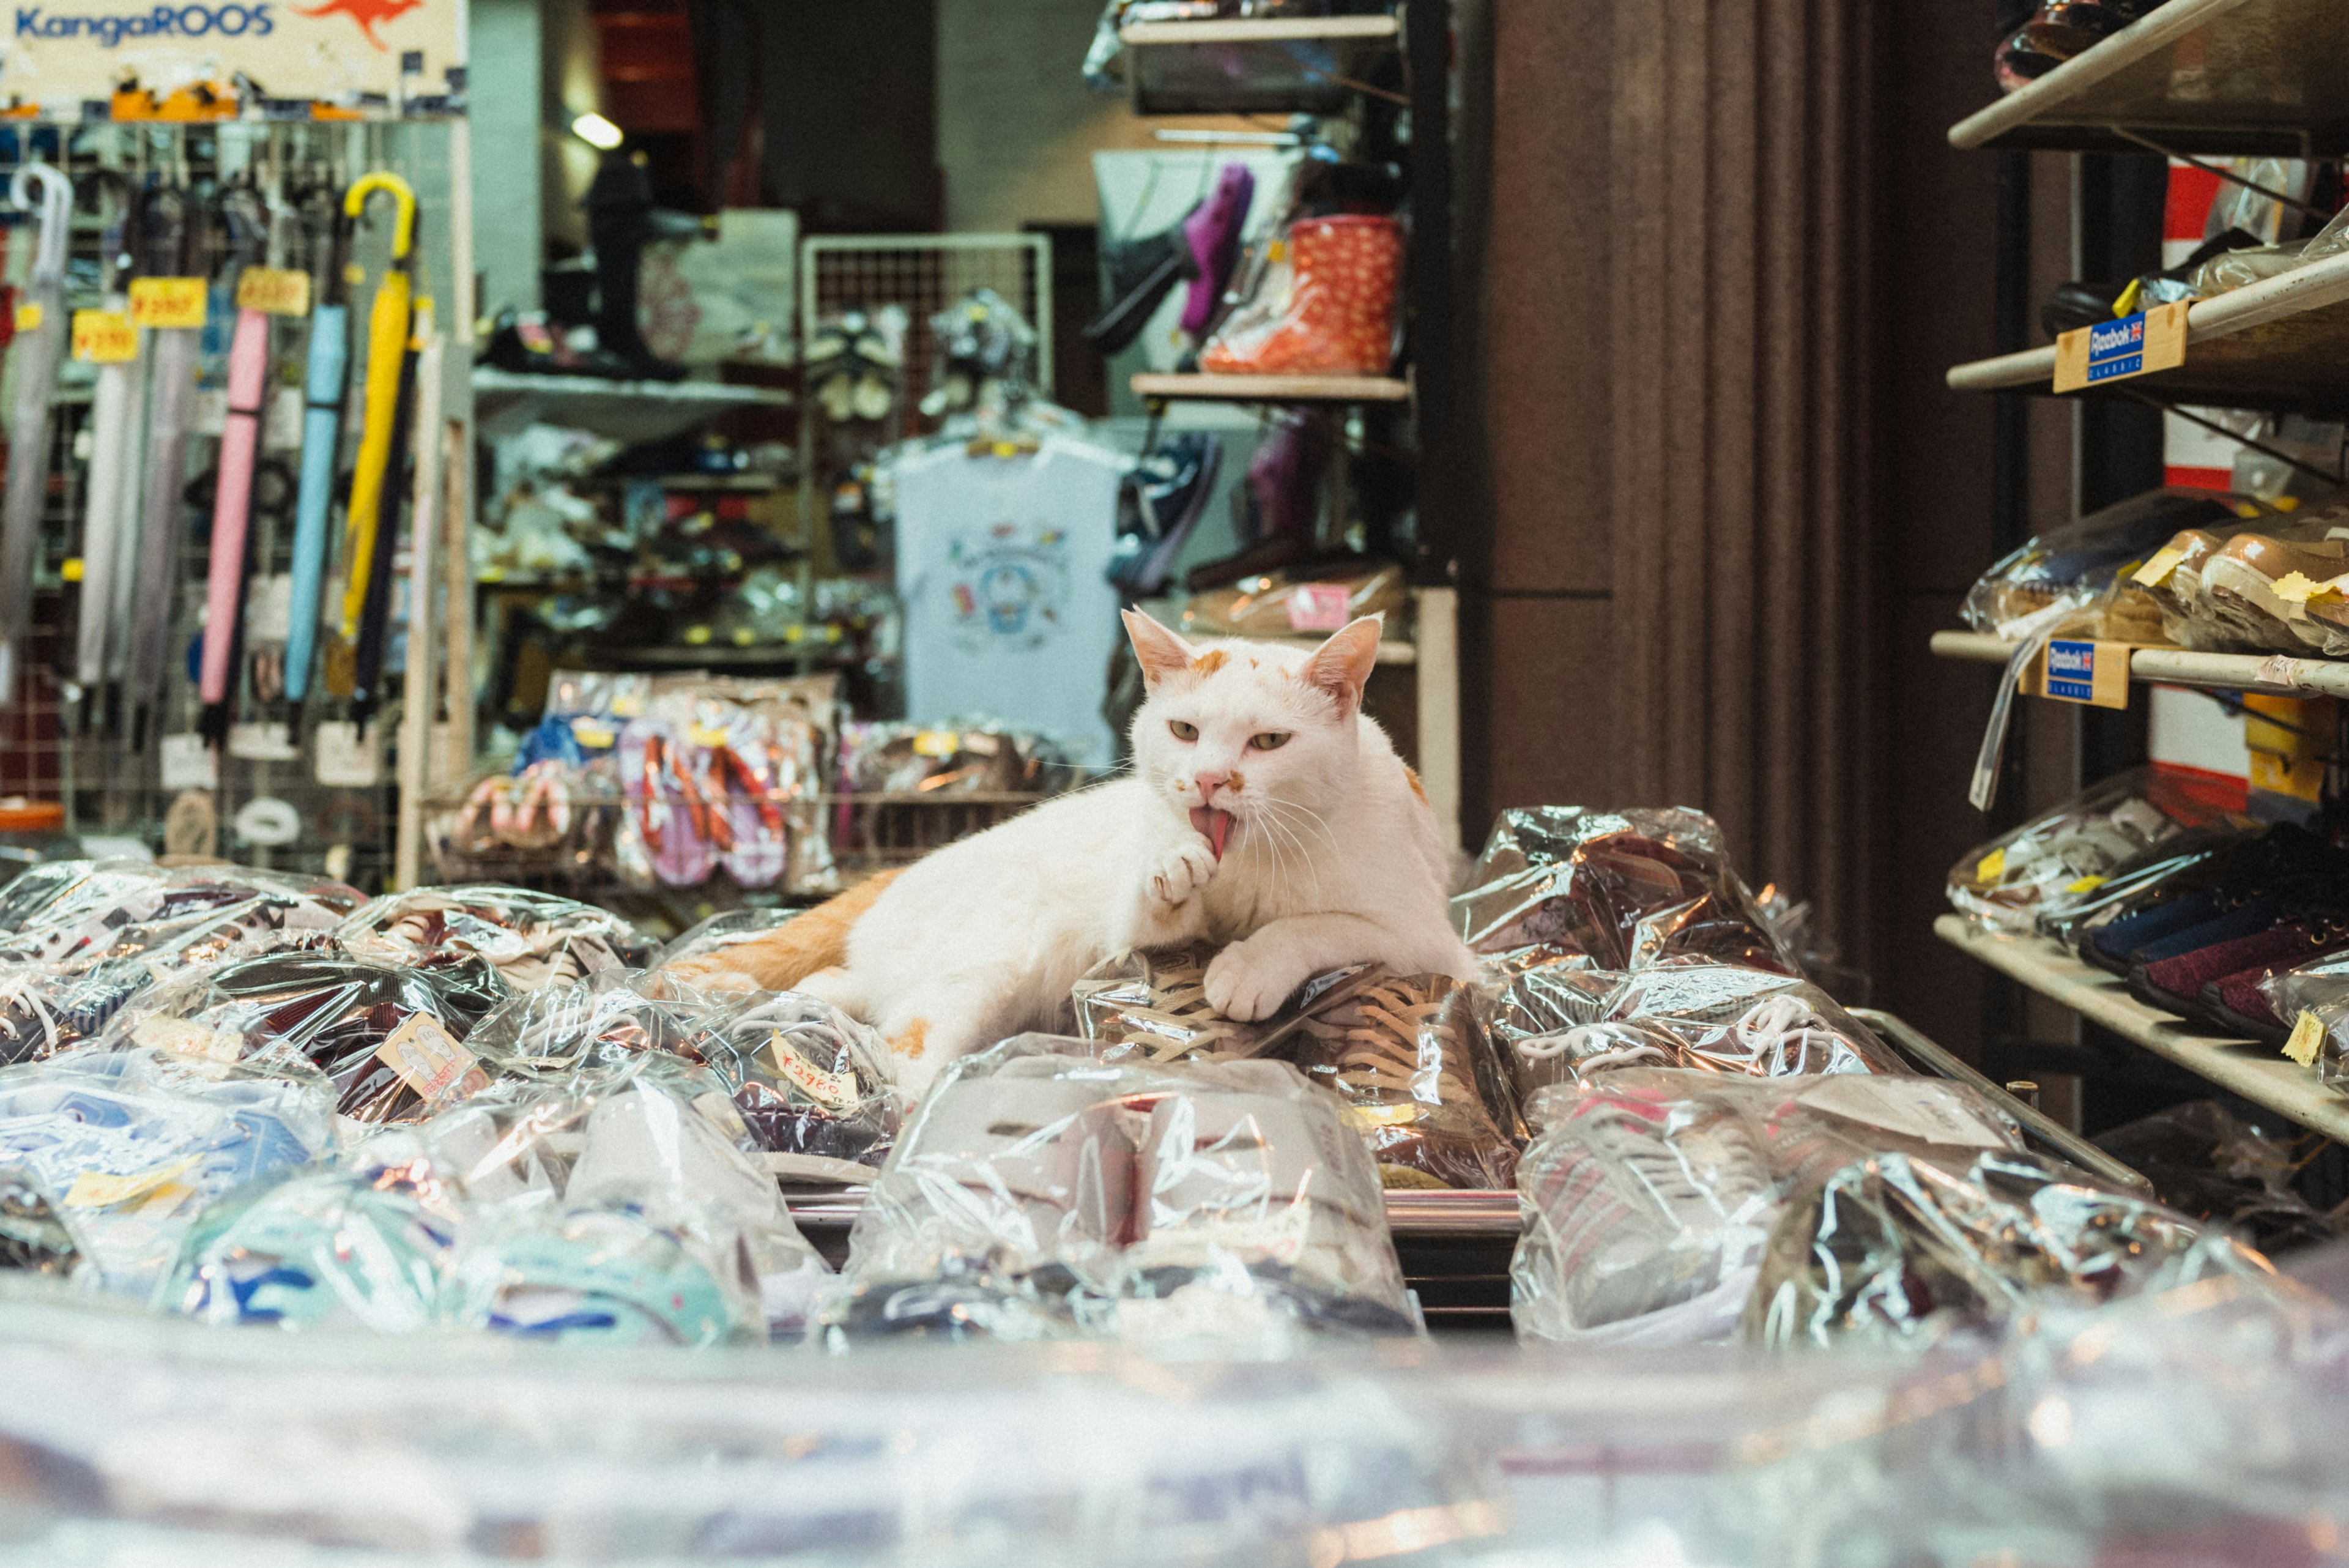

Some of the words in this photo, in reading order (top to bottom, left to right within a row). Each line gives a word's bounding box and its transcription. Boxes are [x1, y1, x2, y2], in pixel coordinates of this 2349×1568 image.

[15, 3, 273, 48] KangaROOS
[2090, 324, 2131, 357] Reebok
[2049, 647, 2082, 672] Reebok
[782, 1049, 839, 1094] ¥2980
